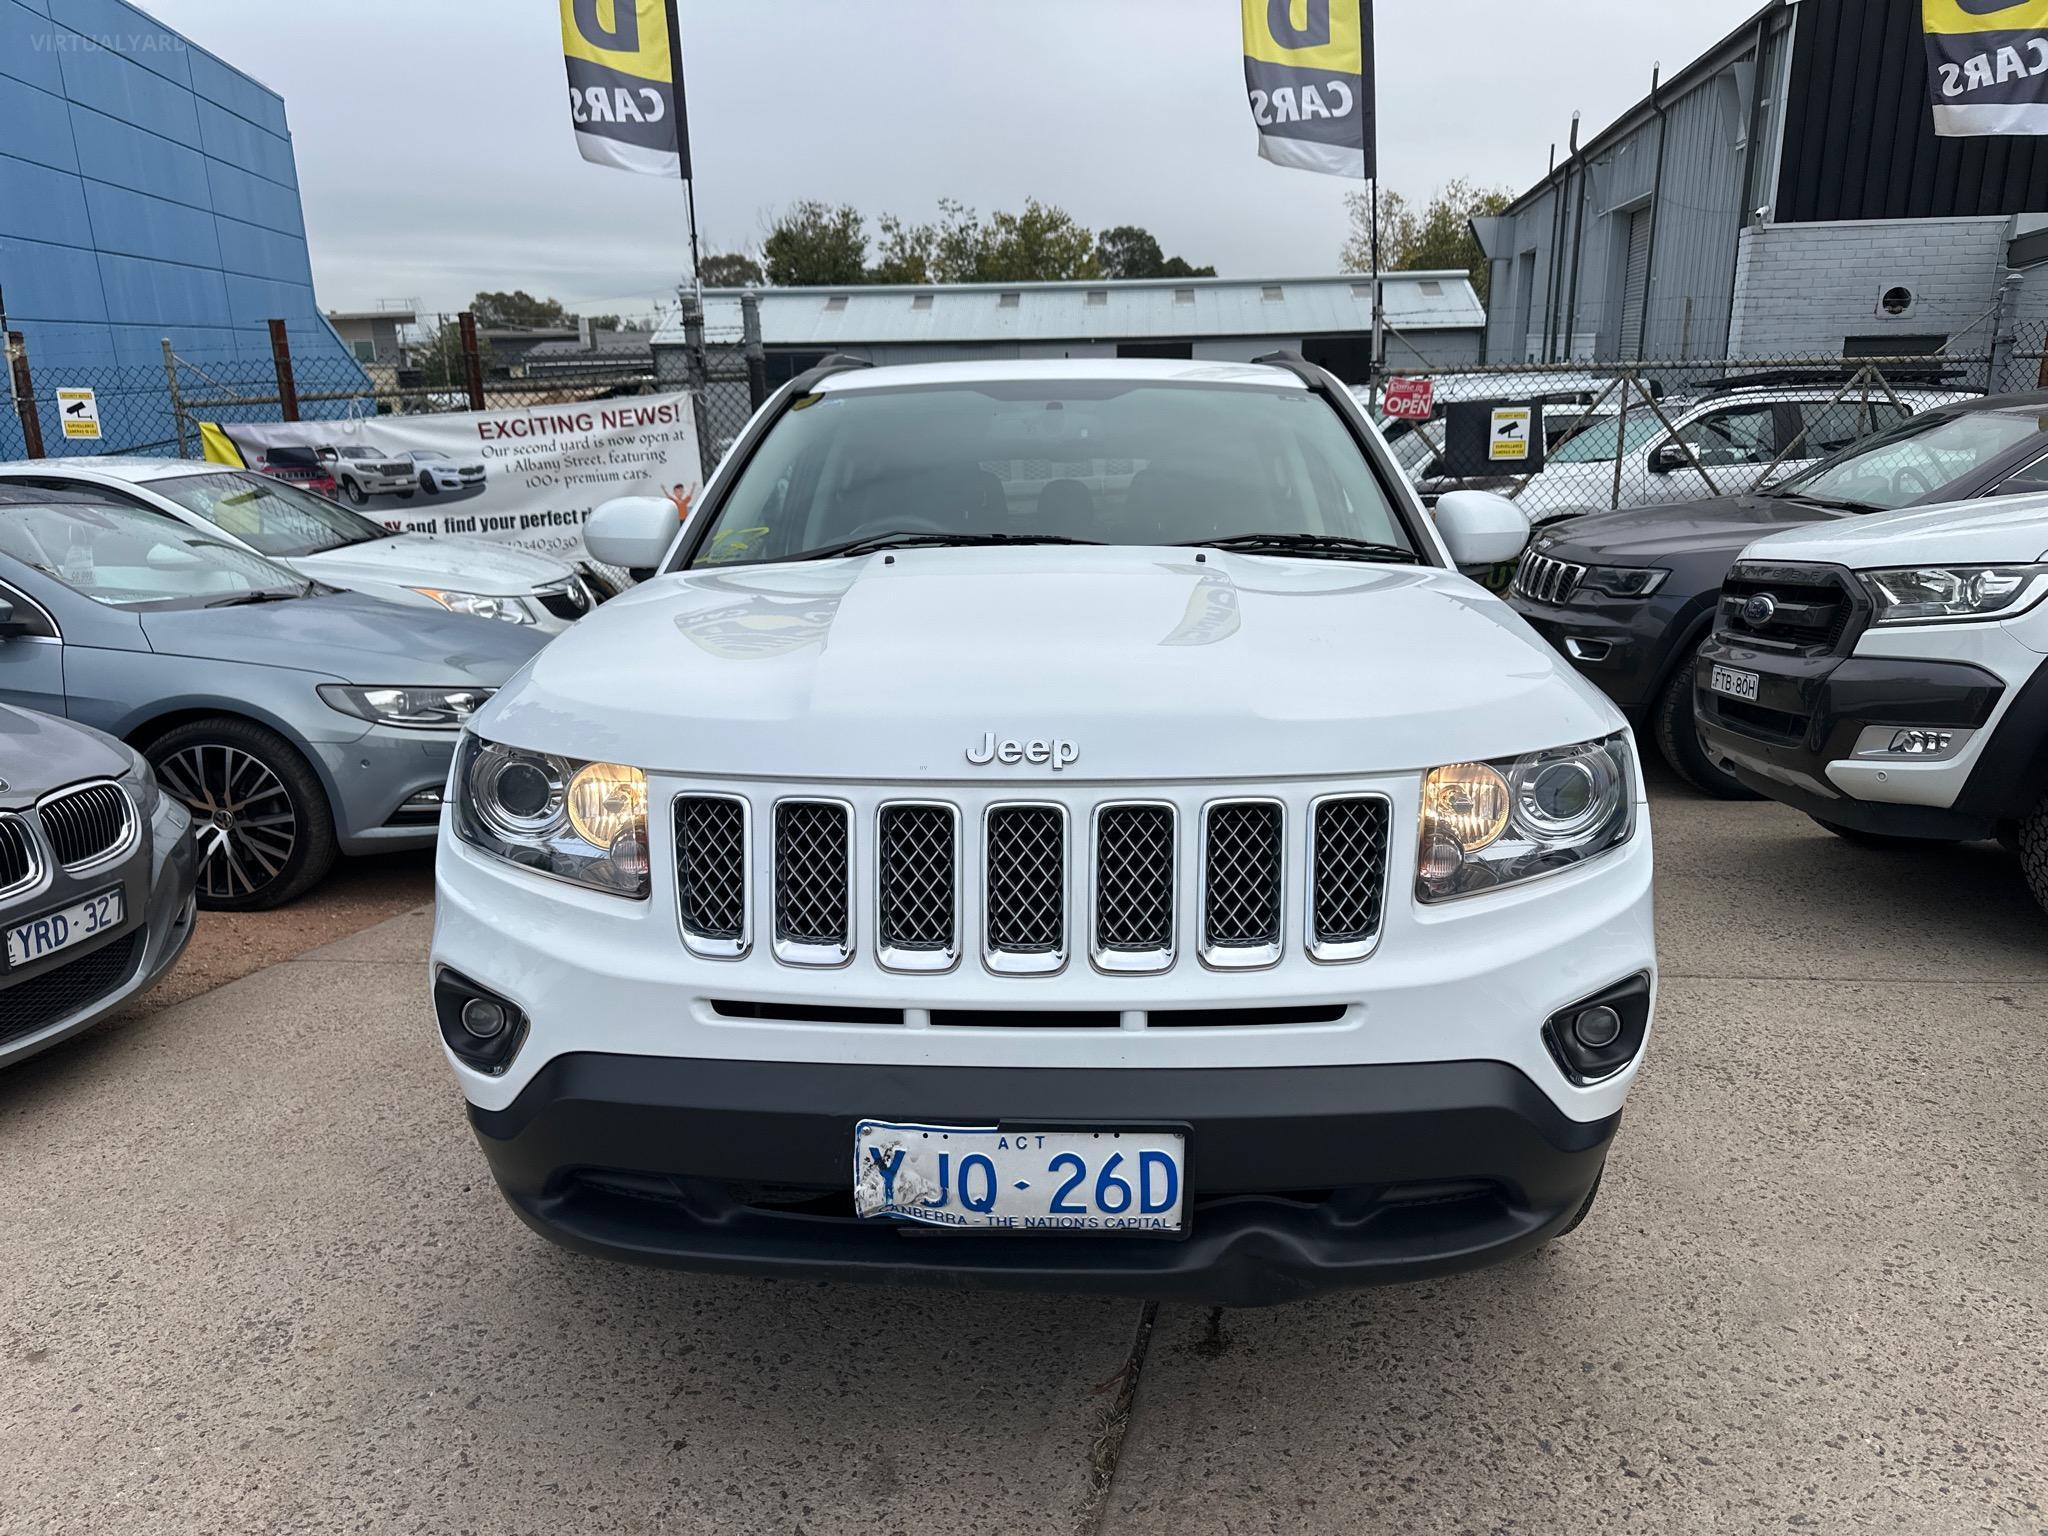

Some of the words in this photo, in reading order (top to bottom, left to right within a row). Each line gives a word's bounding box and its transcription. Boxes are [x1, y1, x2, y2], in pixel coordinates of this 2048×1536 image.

[1386, 397, 1431, 414] OPEN
[478, 413, 593, 440] EXCITING
[601, 404, 680, 430] NEWS!
[481, 445, 510, 459] Our
[513, 439, 557, 456] second
[560, 436, 590, 456] yard
[593, 434, 605, 449] is
[607, 435, 636, 447] now
[639, 431, 670, 448] open
[673, 430, 685, 441] at
[505, 464, 511, 474] 1
[514, 458, 560, 474] Albany
[608, 448, 668, 465] featuring
[526, 474, 560, 489] 100+
[563, 468, 620, 489] premium
[622, 468, 652, 482] cars.
[406, 519, 437, 535] and
[444, 516, 476, 534] find
[479, 515, 517, 534] your
[520, 508, 578, 531] perfect
[966, 732, 1079, 771] Jeep
[998, 1135, 1046, 1150] ACT
[986, 1215, 1018, 1228] THE
[1104, 1216, 1172, 1229] CAPITAL
